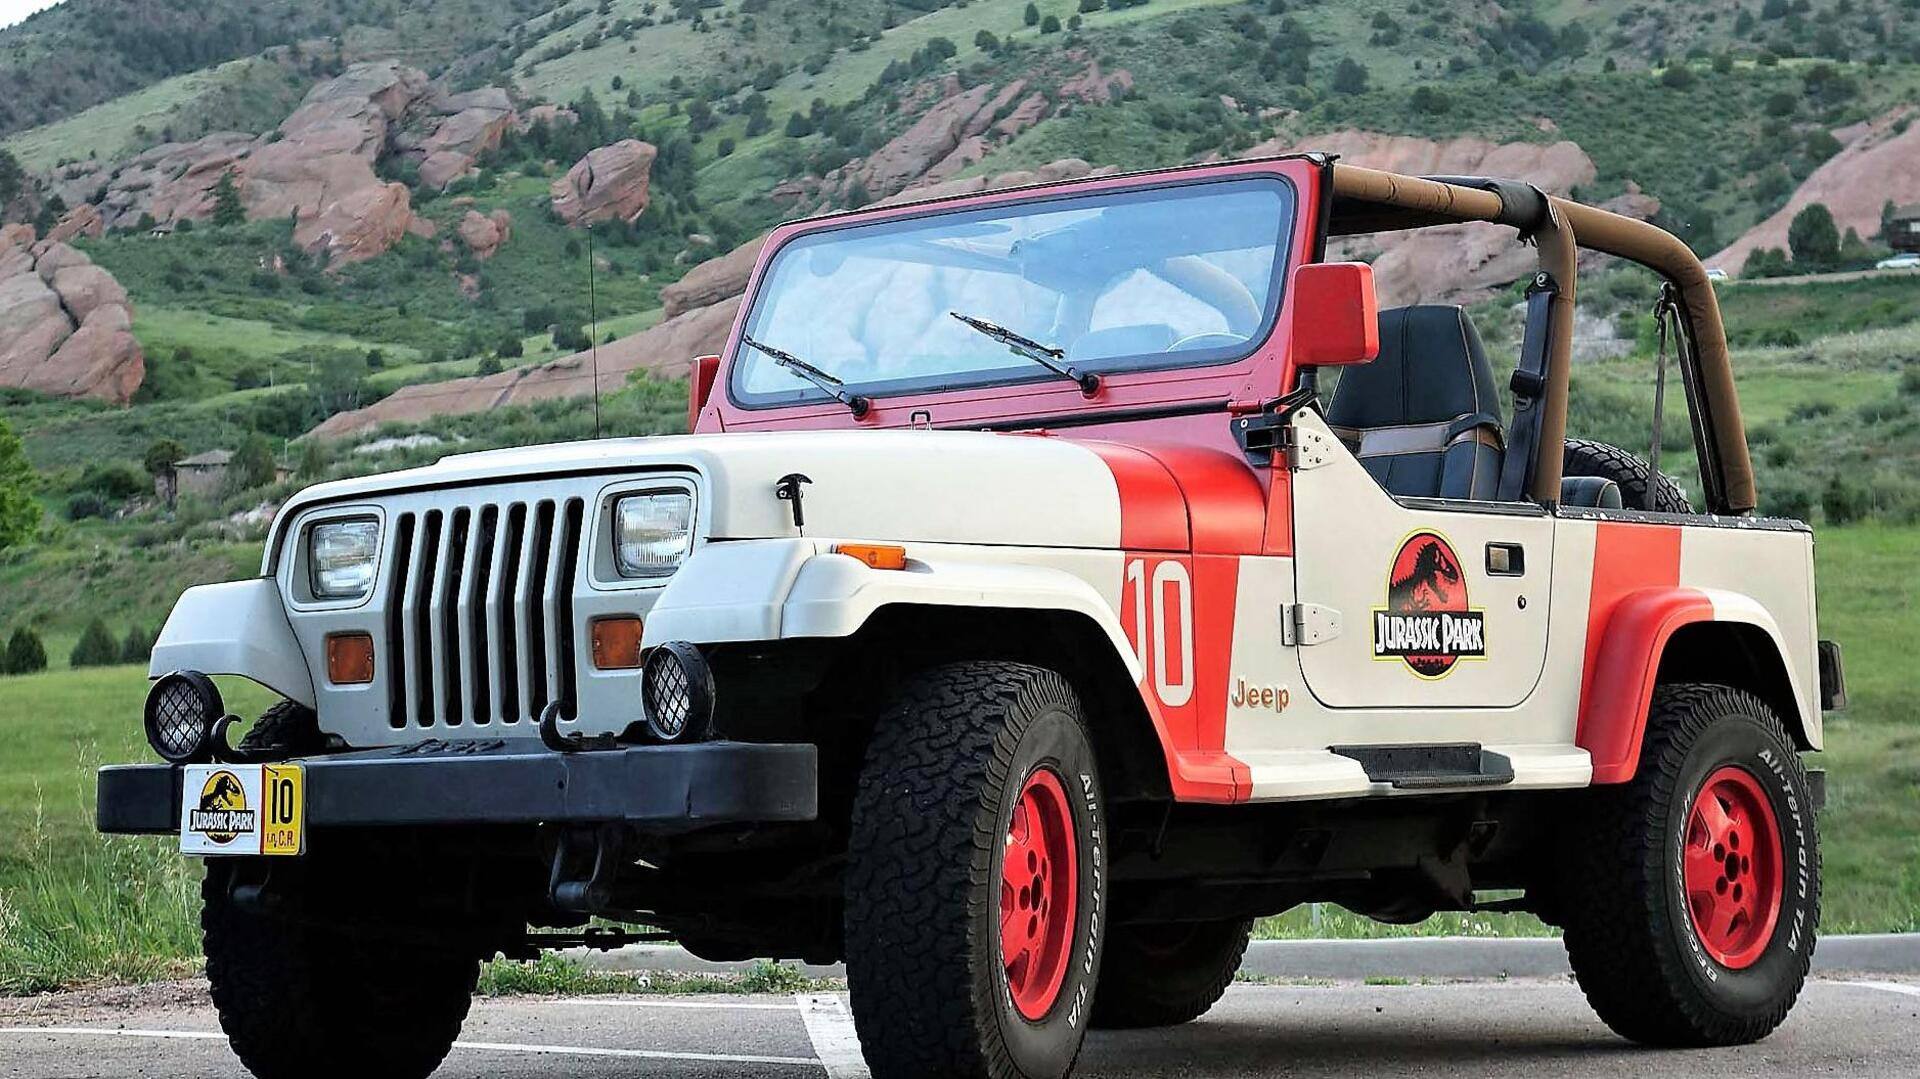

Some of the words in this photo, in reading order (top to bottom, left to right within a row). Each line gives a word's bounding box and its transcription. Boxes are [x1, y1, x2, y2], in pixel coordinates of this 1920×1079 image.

[1127, 558, 1194, 707] 10
[1376, 612, 1440, 653] JURASSIC
[1442, 613, 1483, 654] PARK
[1231, 678, 1289, 713] Jeep
[191, 810, 228, 831] JURASSIC
[229, 810, 253, 832] PARK
[271, 778, 294, 824] 10
